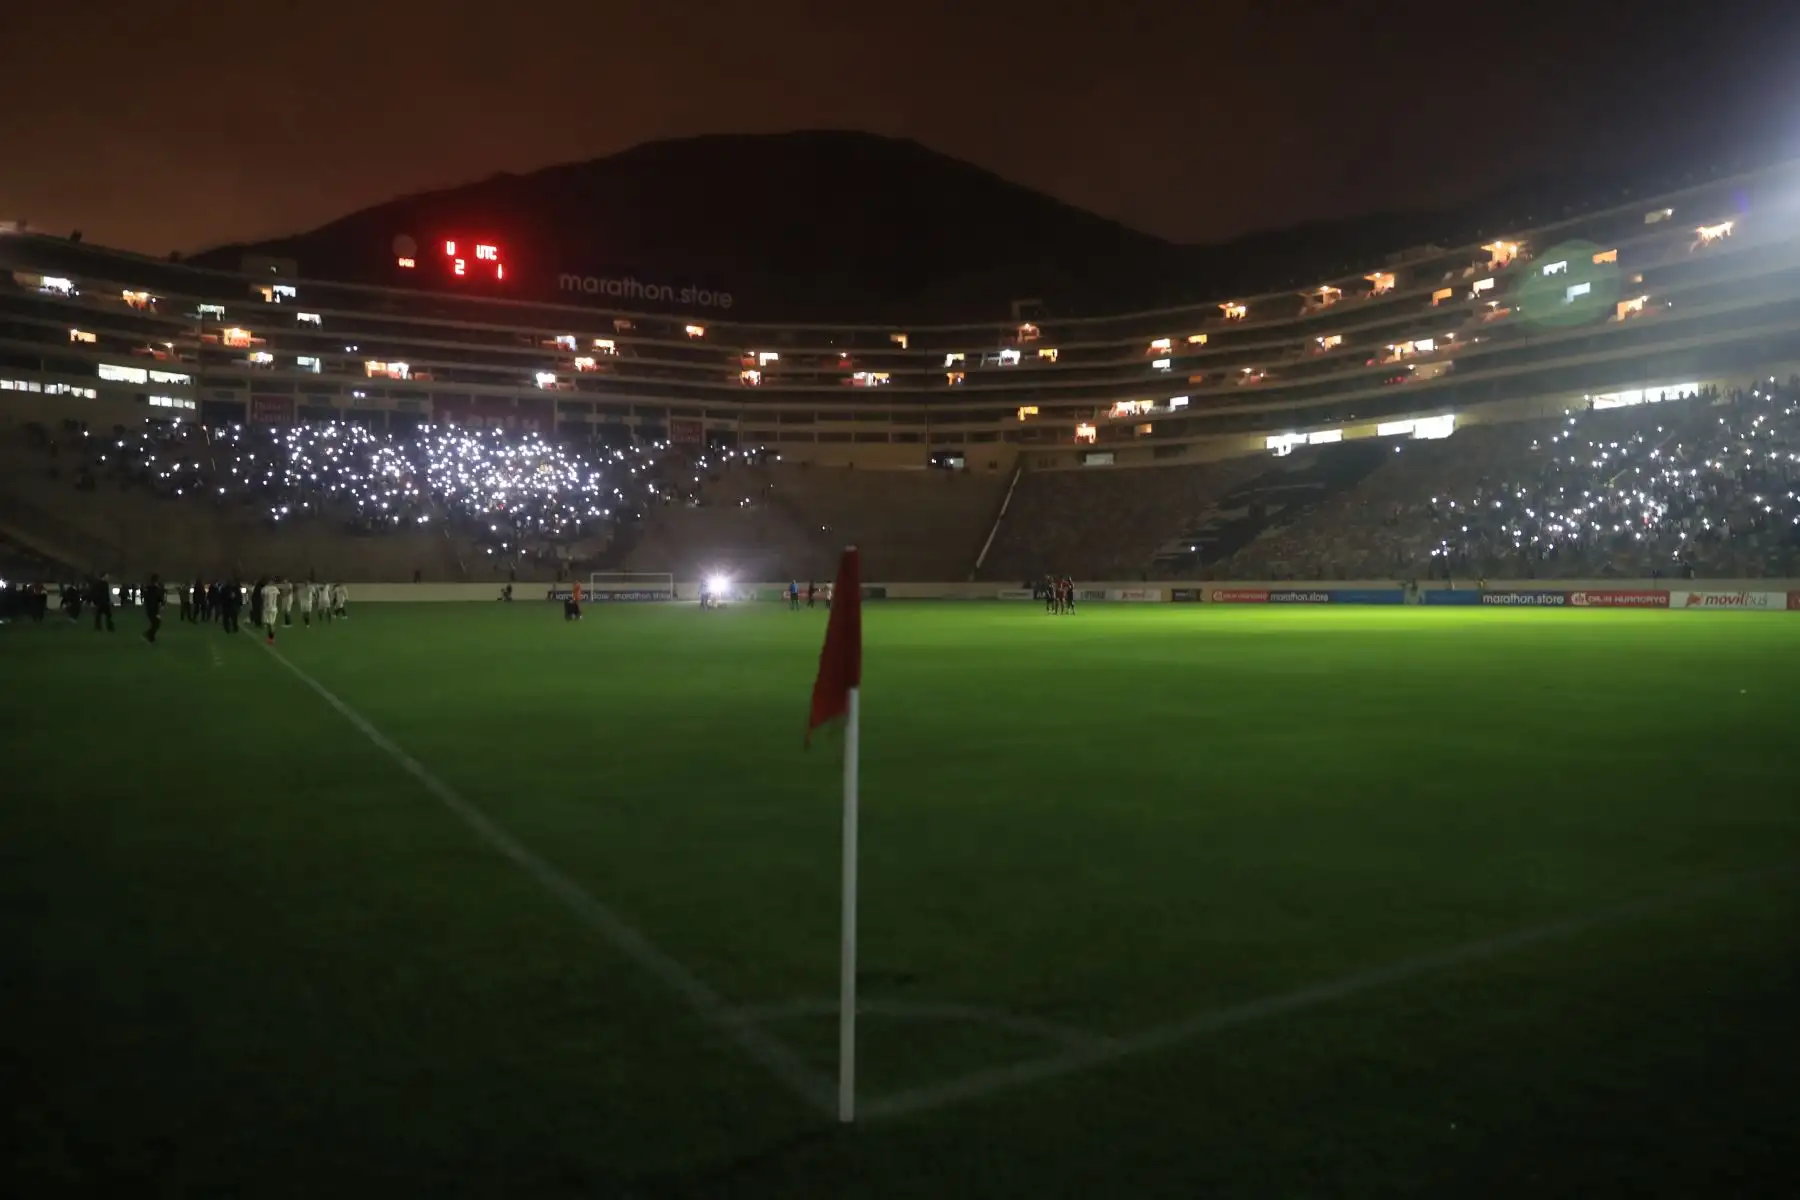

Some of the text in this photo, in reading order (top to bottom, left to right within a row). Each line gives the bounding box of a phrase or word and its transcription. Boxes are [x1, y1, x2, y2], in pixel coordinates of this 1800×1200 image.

[476, 244, 498, 261] UTC
[454, 258, 503, 280] 2 1
[558, 273, 733, 309] marathon.store
[1482, 592, 1565, 605] marathon.store
